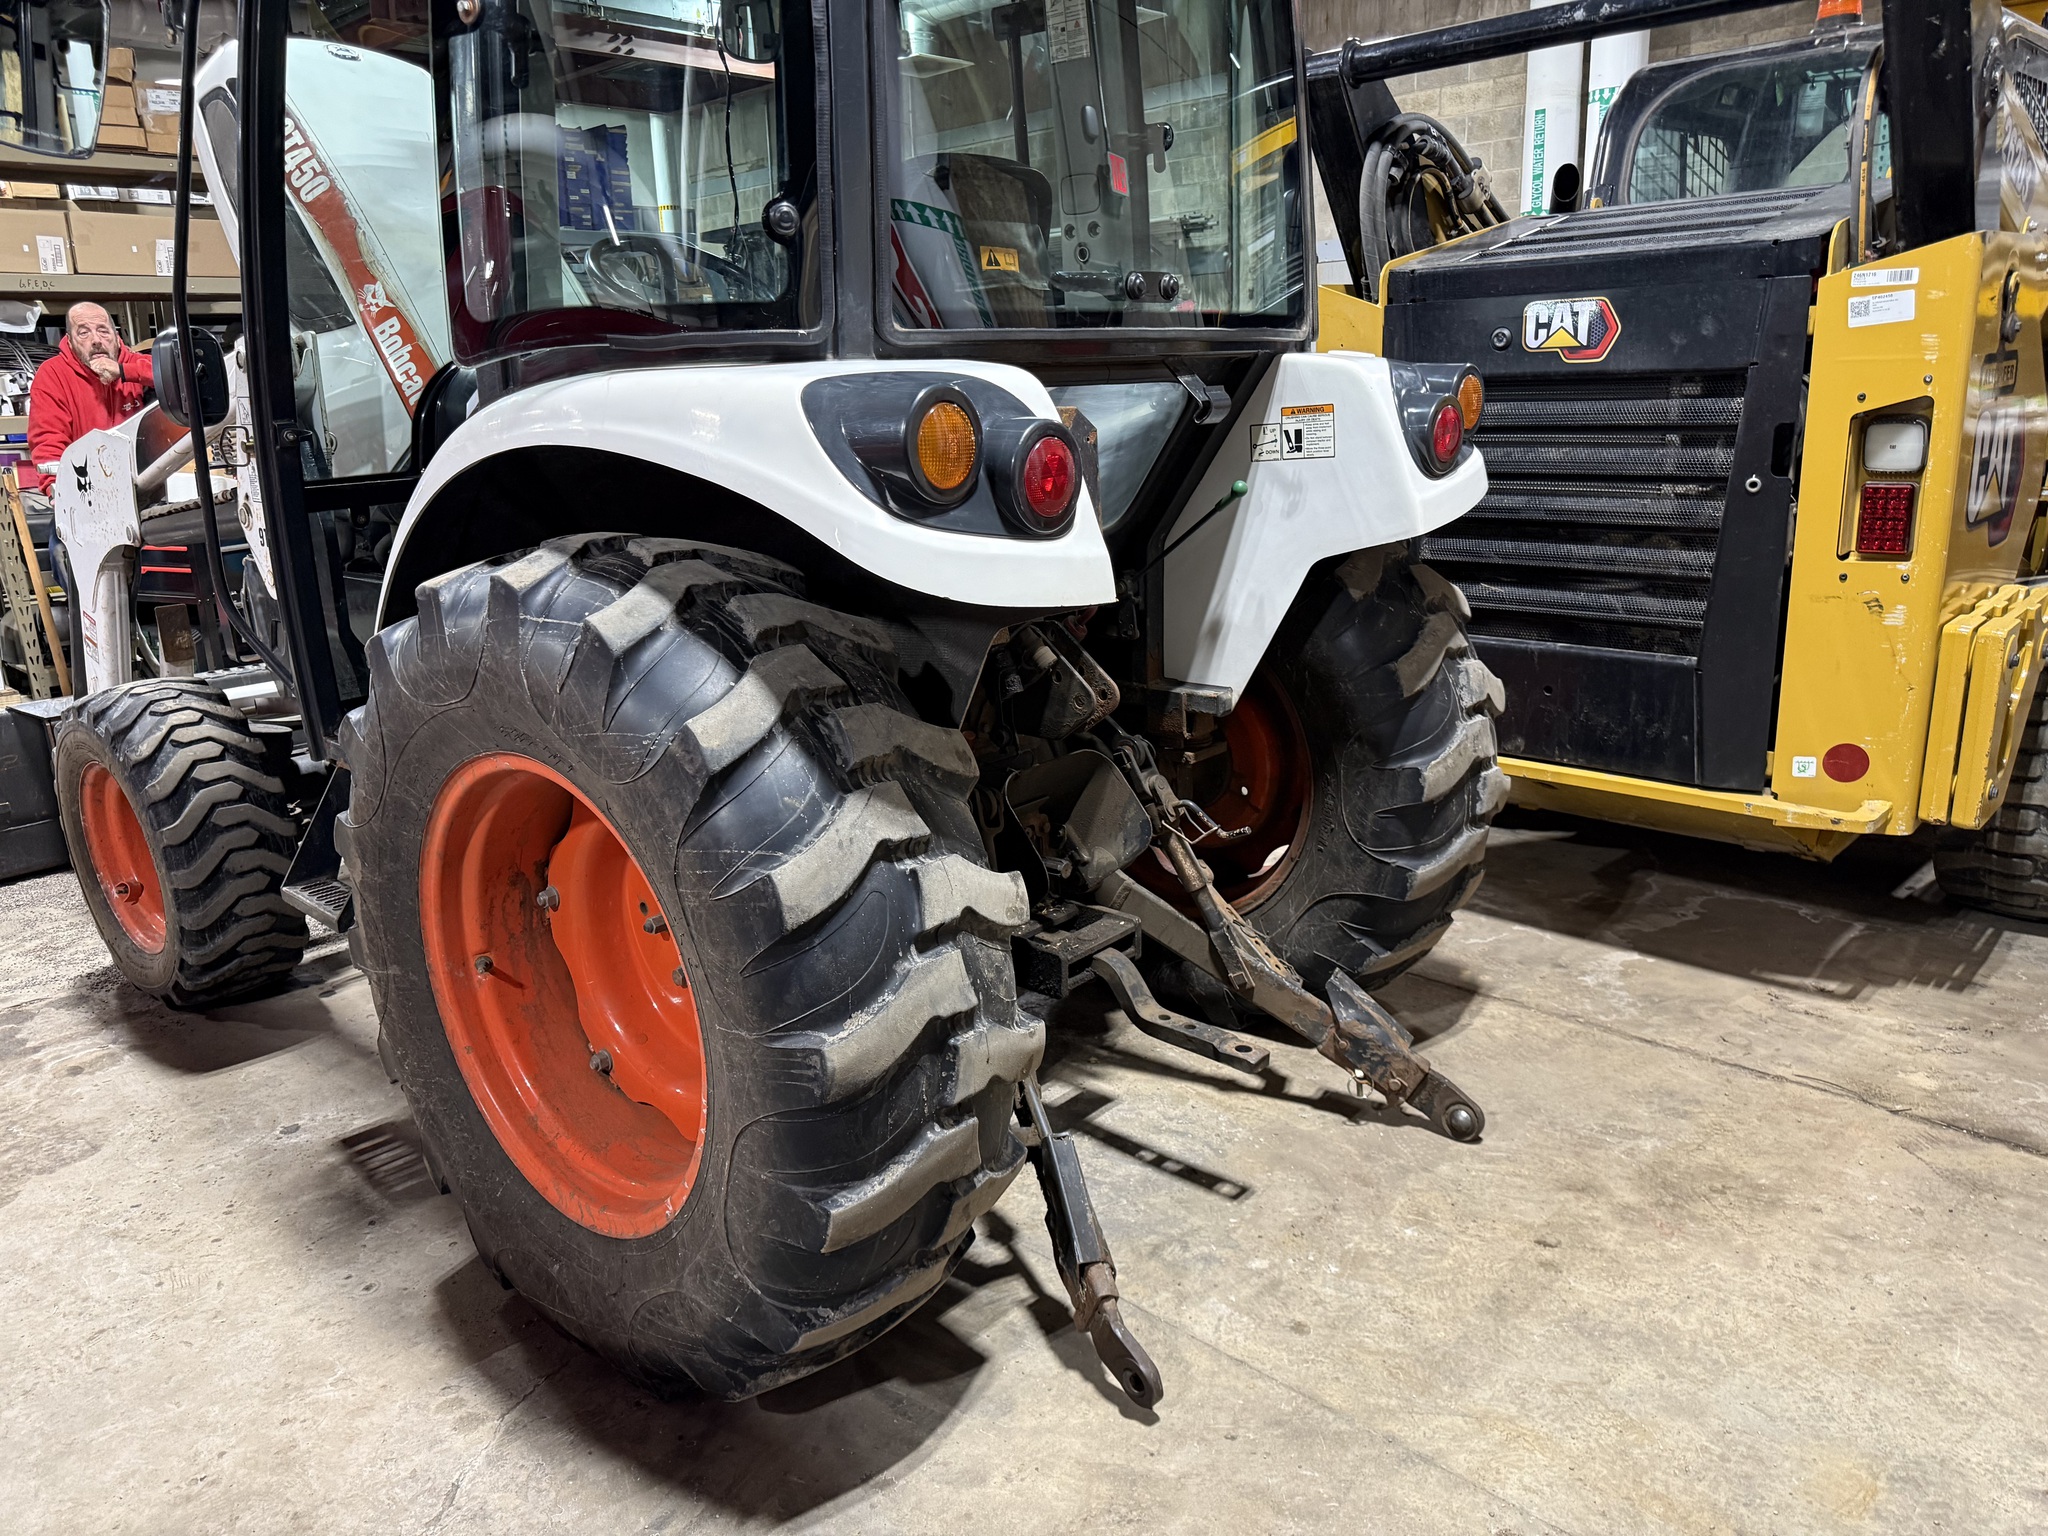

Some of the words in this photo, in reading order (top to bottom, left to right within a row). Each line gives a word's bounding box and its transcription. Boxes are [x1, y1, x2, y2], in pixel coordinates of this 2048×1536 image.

[1534, 113, 1545, 145] RETURN
[1533, 148, 1544, 176] WATER
[1531, 177, 1543, 208] GLYCOL
[1526, 300, 1596, 349] CAT
[1296, 406, 1325, 414] WARNING
[1967, 407, 2021, 523] CAT
